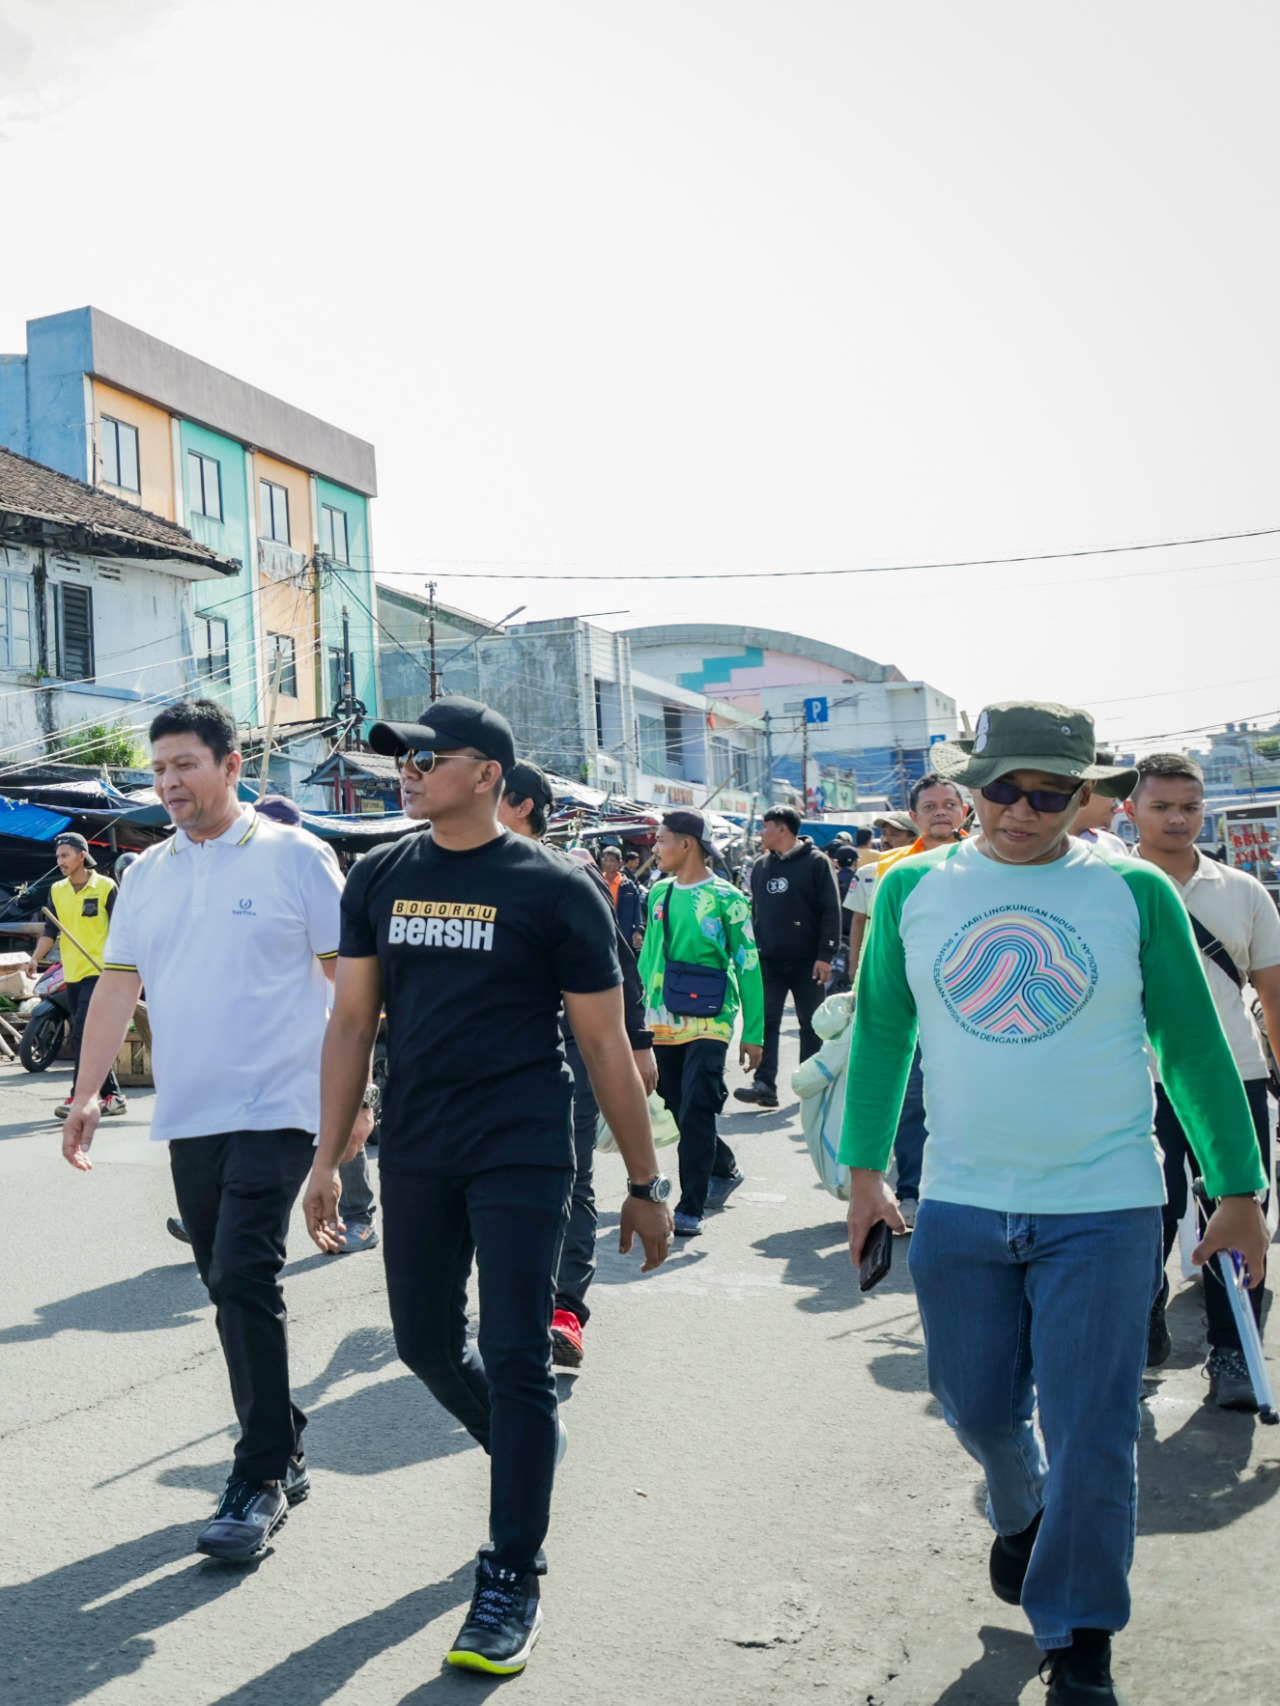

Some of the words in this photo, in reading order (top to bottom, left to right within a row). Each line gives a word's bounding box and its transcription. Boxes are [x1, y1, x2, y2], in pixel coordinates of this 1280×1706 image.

[812, 701, 822, 720] P
[396, 902, 493, 919] BOGORKU
[960, 914, 982, 931] HARI
[983, 904, 1048, 917] LINGKUNGAN
[1049, 914, 1077, 934] HIDUP
[933, 938, 954, 999] PENYELESAIAN
[1080, 942, 1099, 986] KEADILAN
[943, 998, 960, 1024] KRISIS
[1072, 986, 1095, 1017] PRINSIP
[960, 1019, 980, 1038] IKLIM
[1056, 1015, 1073, 1032] DAN
[979, 1032, 1019, 1045] DENGAN
[1020, 1026, 1056, 1045] INOVASI
